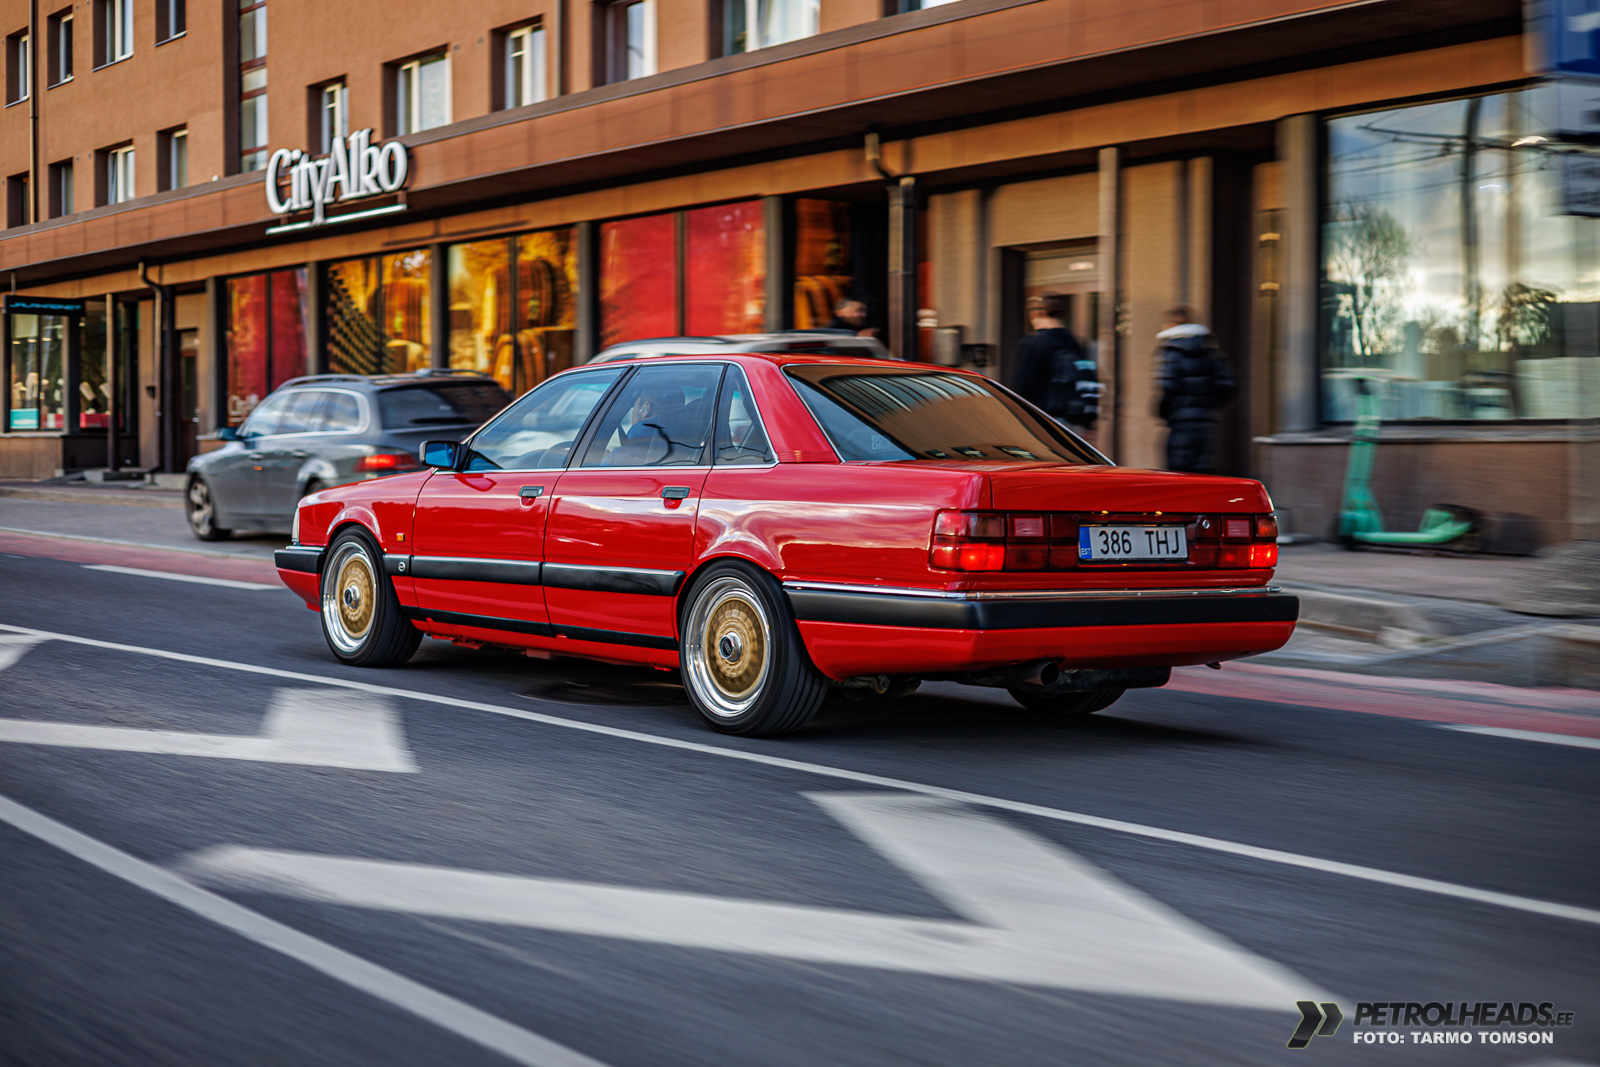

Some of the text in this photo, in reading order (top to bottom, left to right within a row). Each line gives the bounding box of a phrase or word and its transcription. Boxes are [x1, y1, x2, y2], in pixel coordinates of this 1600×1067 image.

[266, 128, 407, 225] CityAlko
[1099, 530, 1179, 555] 386 THJ
